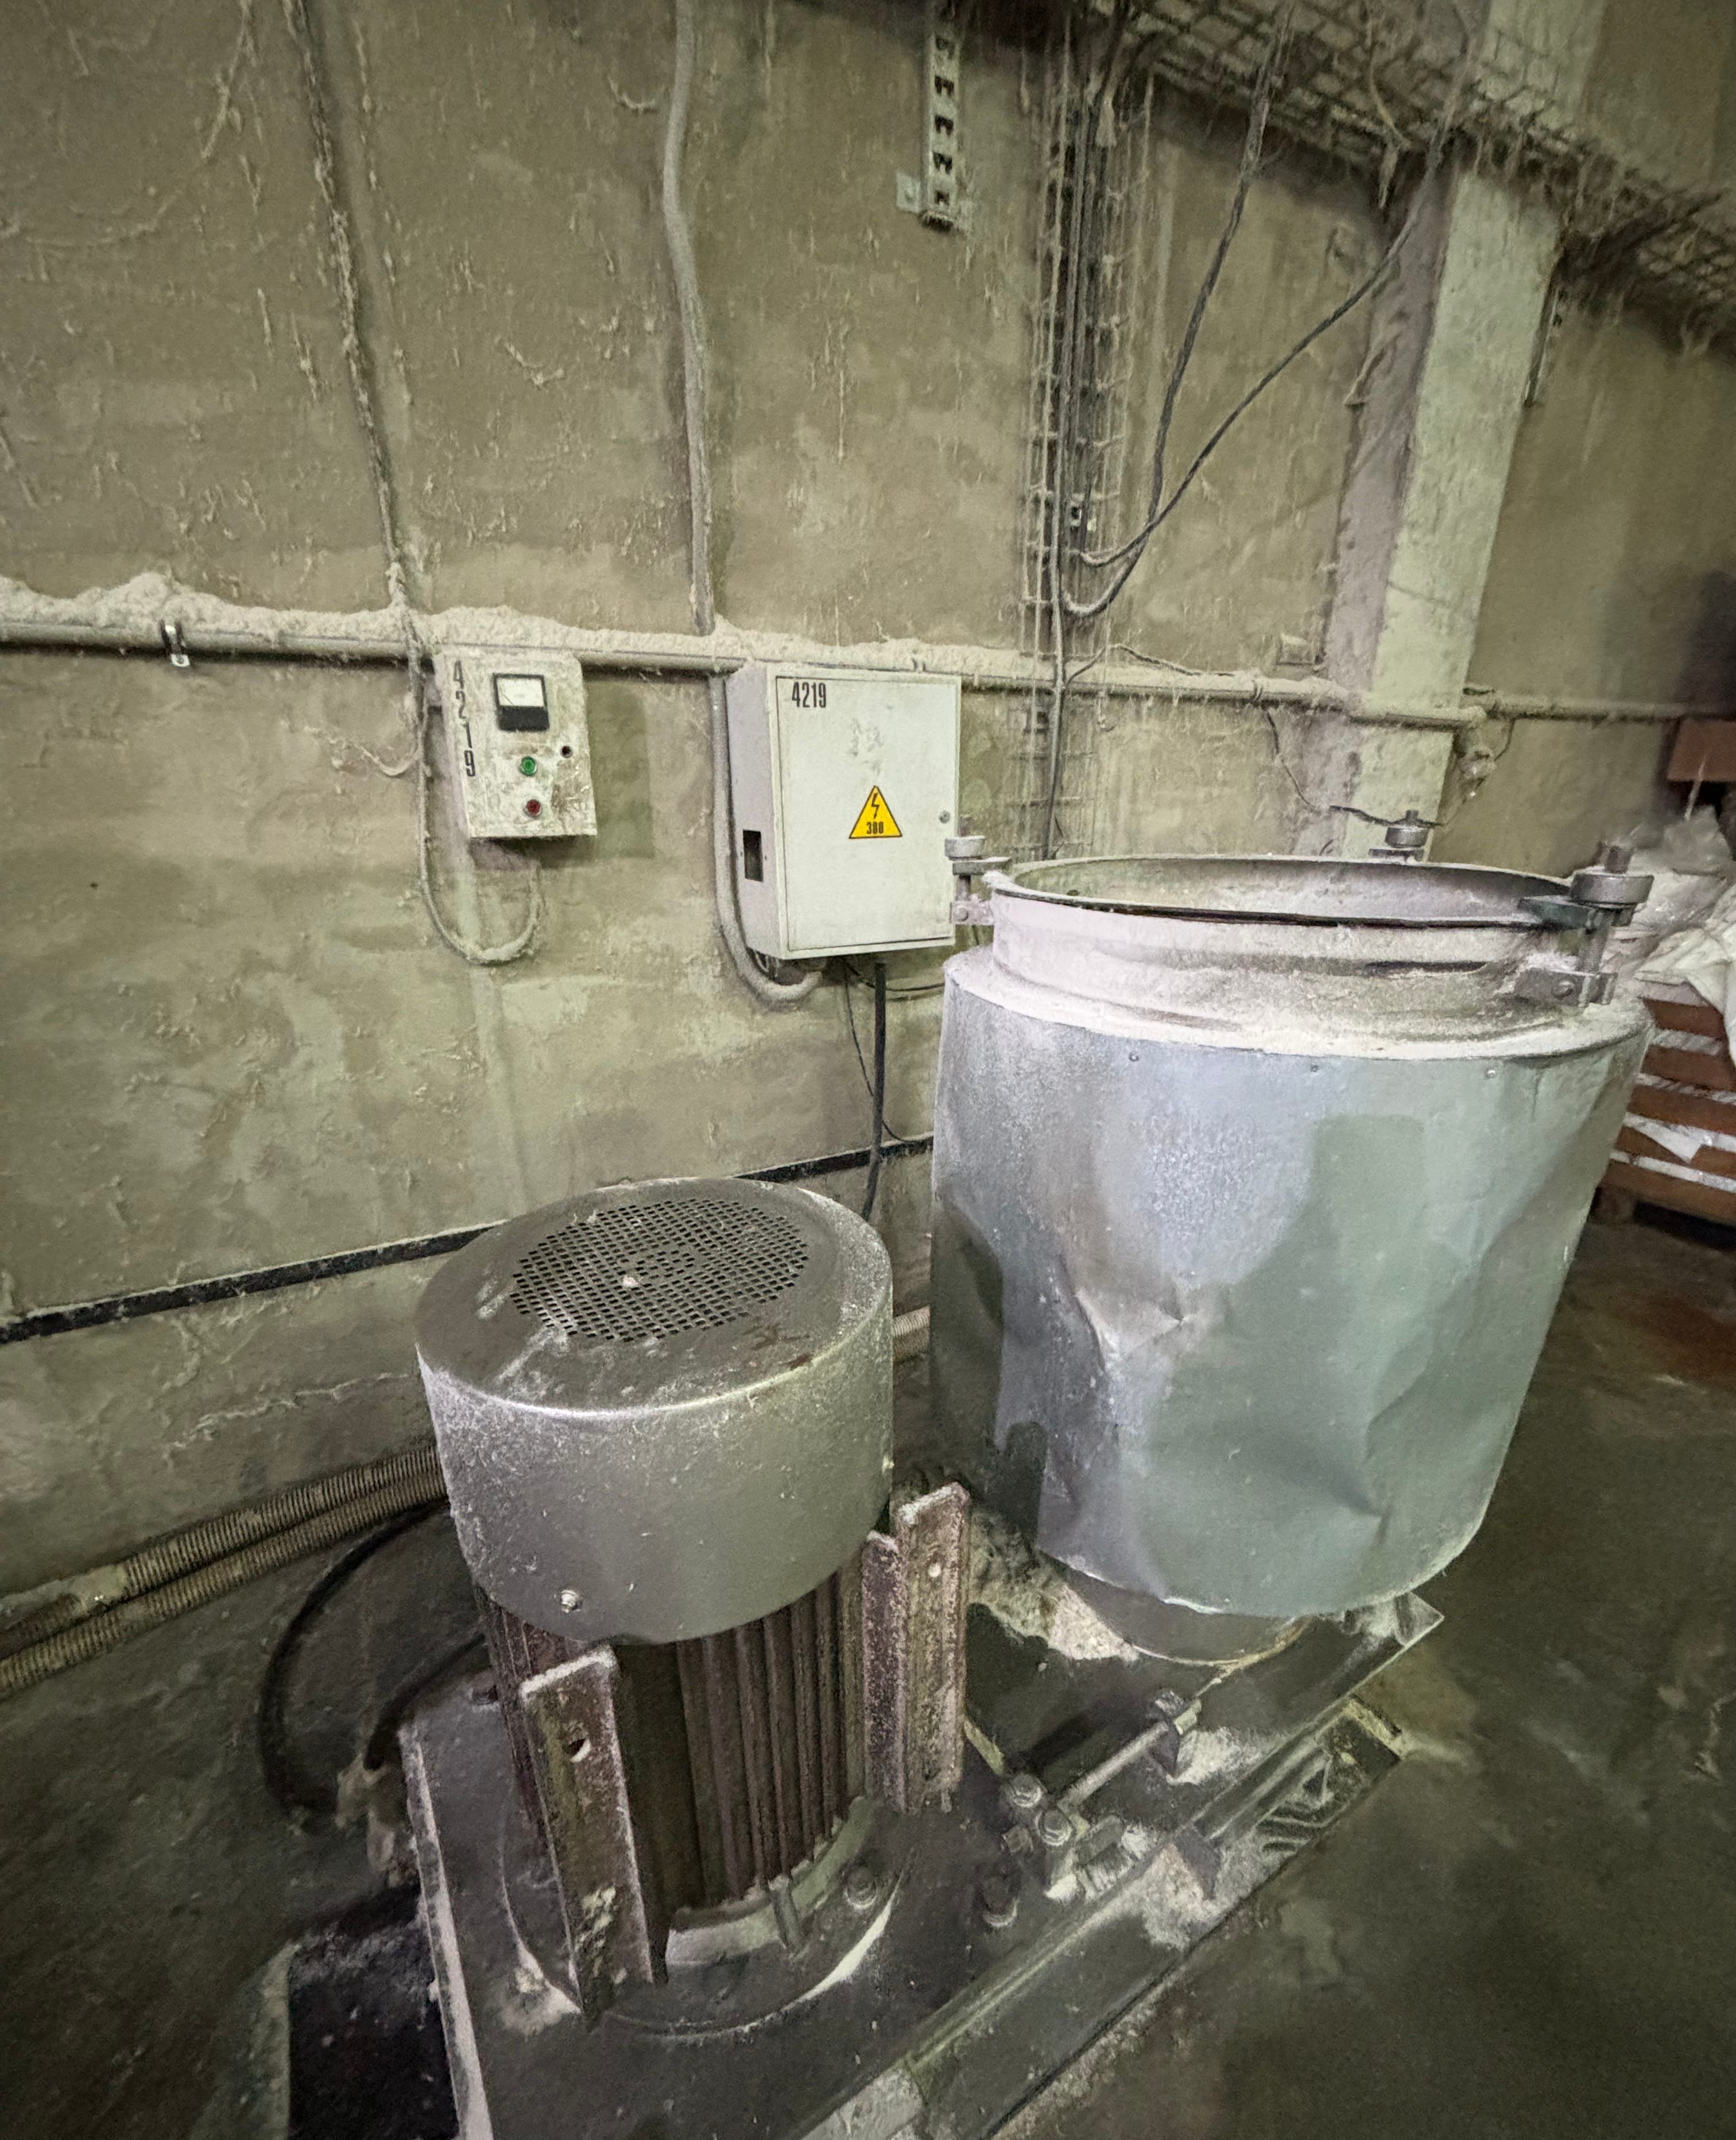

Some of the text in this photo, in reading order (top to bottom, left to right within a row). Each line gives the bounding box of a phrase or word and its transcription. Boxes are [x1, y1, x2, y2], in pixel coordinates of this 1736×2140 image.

[792, 681, 827, 708] 4219
[453, 660, 476, 777] 4219
[866, 821, 884, 835] 380
